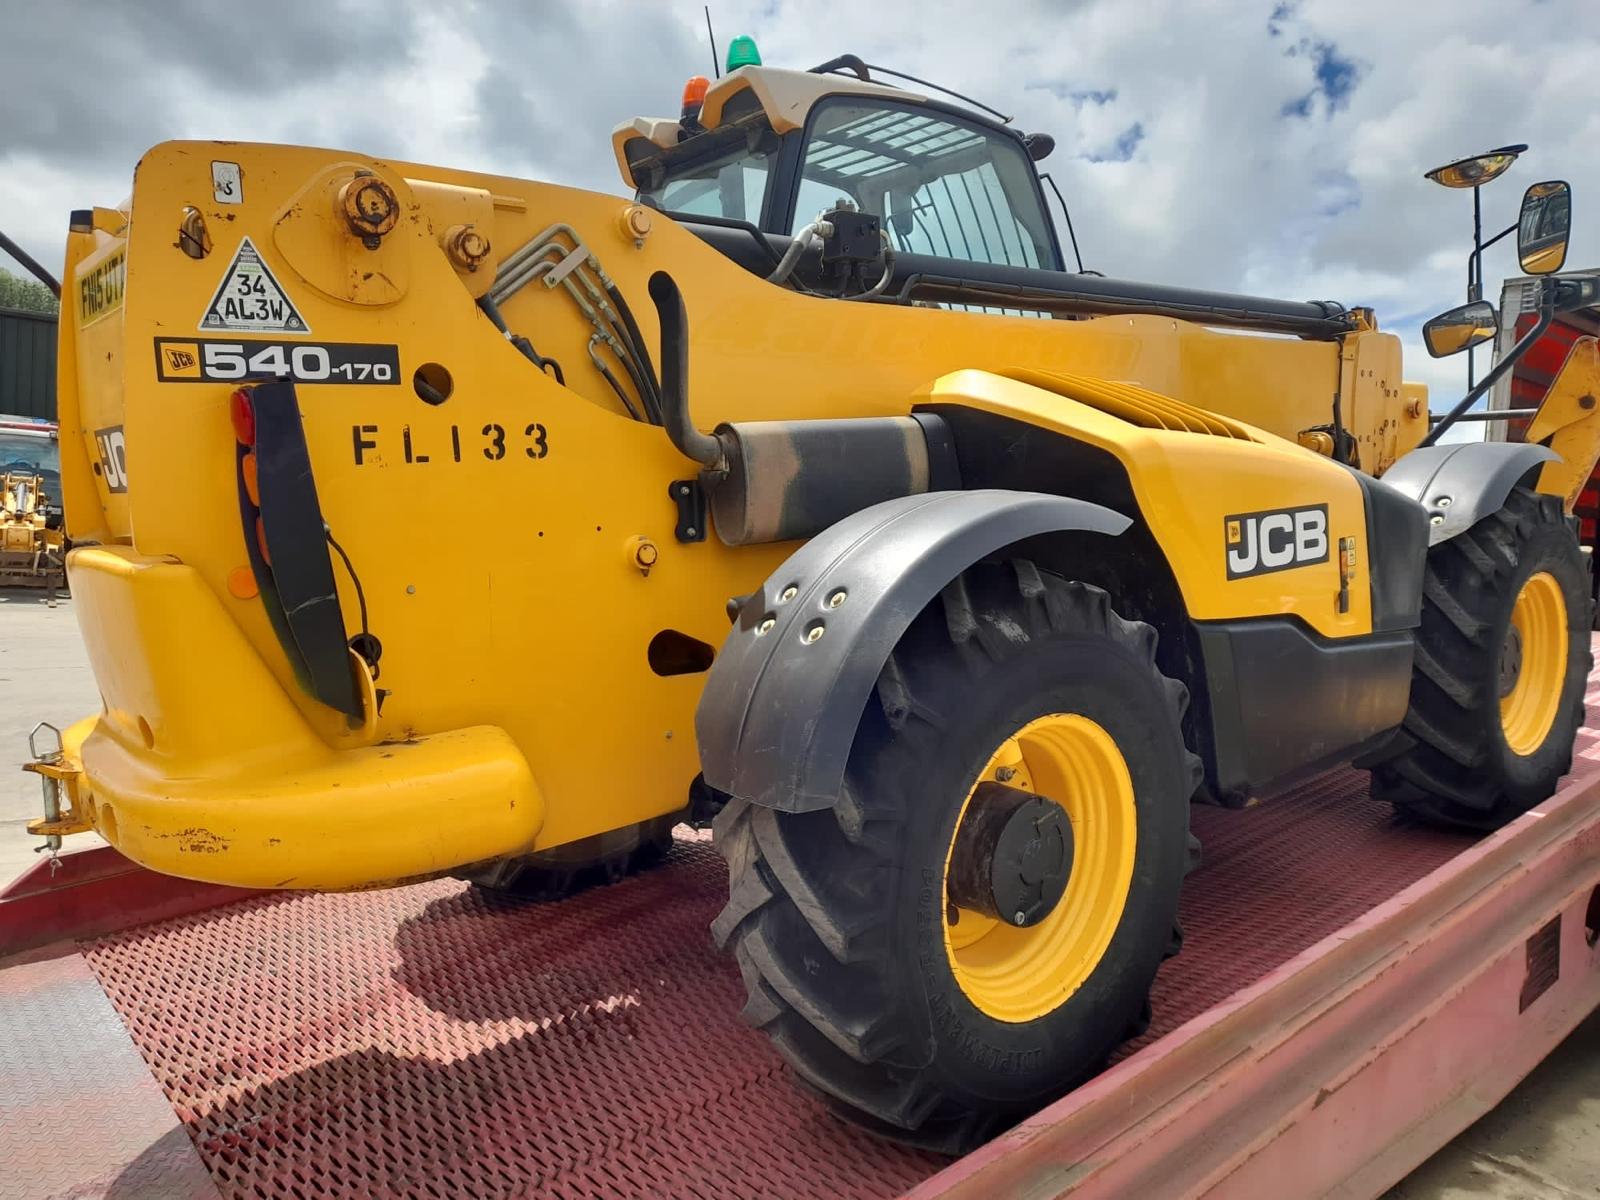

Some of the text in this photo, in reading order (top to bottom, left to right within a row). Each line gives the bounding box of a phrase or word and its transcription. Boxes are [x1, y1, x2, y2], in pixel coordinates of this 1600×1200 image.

[237, 274, 266, 297] 34
[224, 297, 283, 321] AL3W
[171, 343, 392, 380] JCB 540-170
[1228, 509, 1327, 574] JCB
